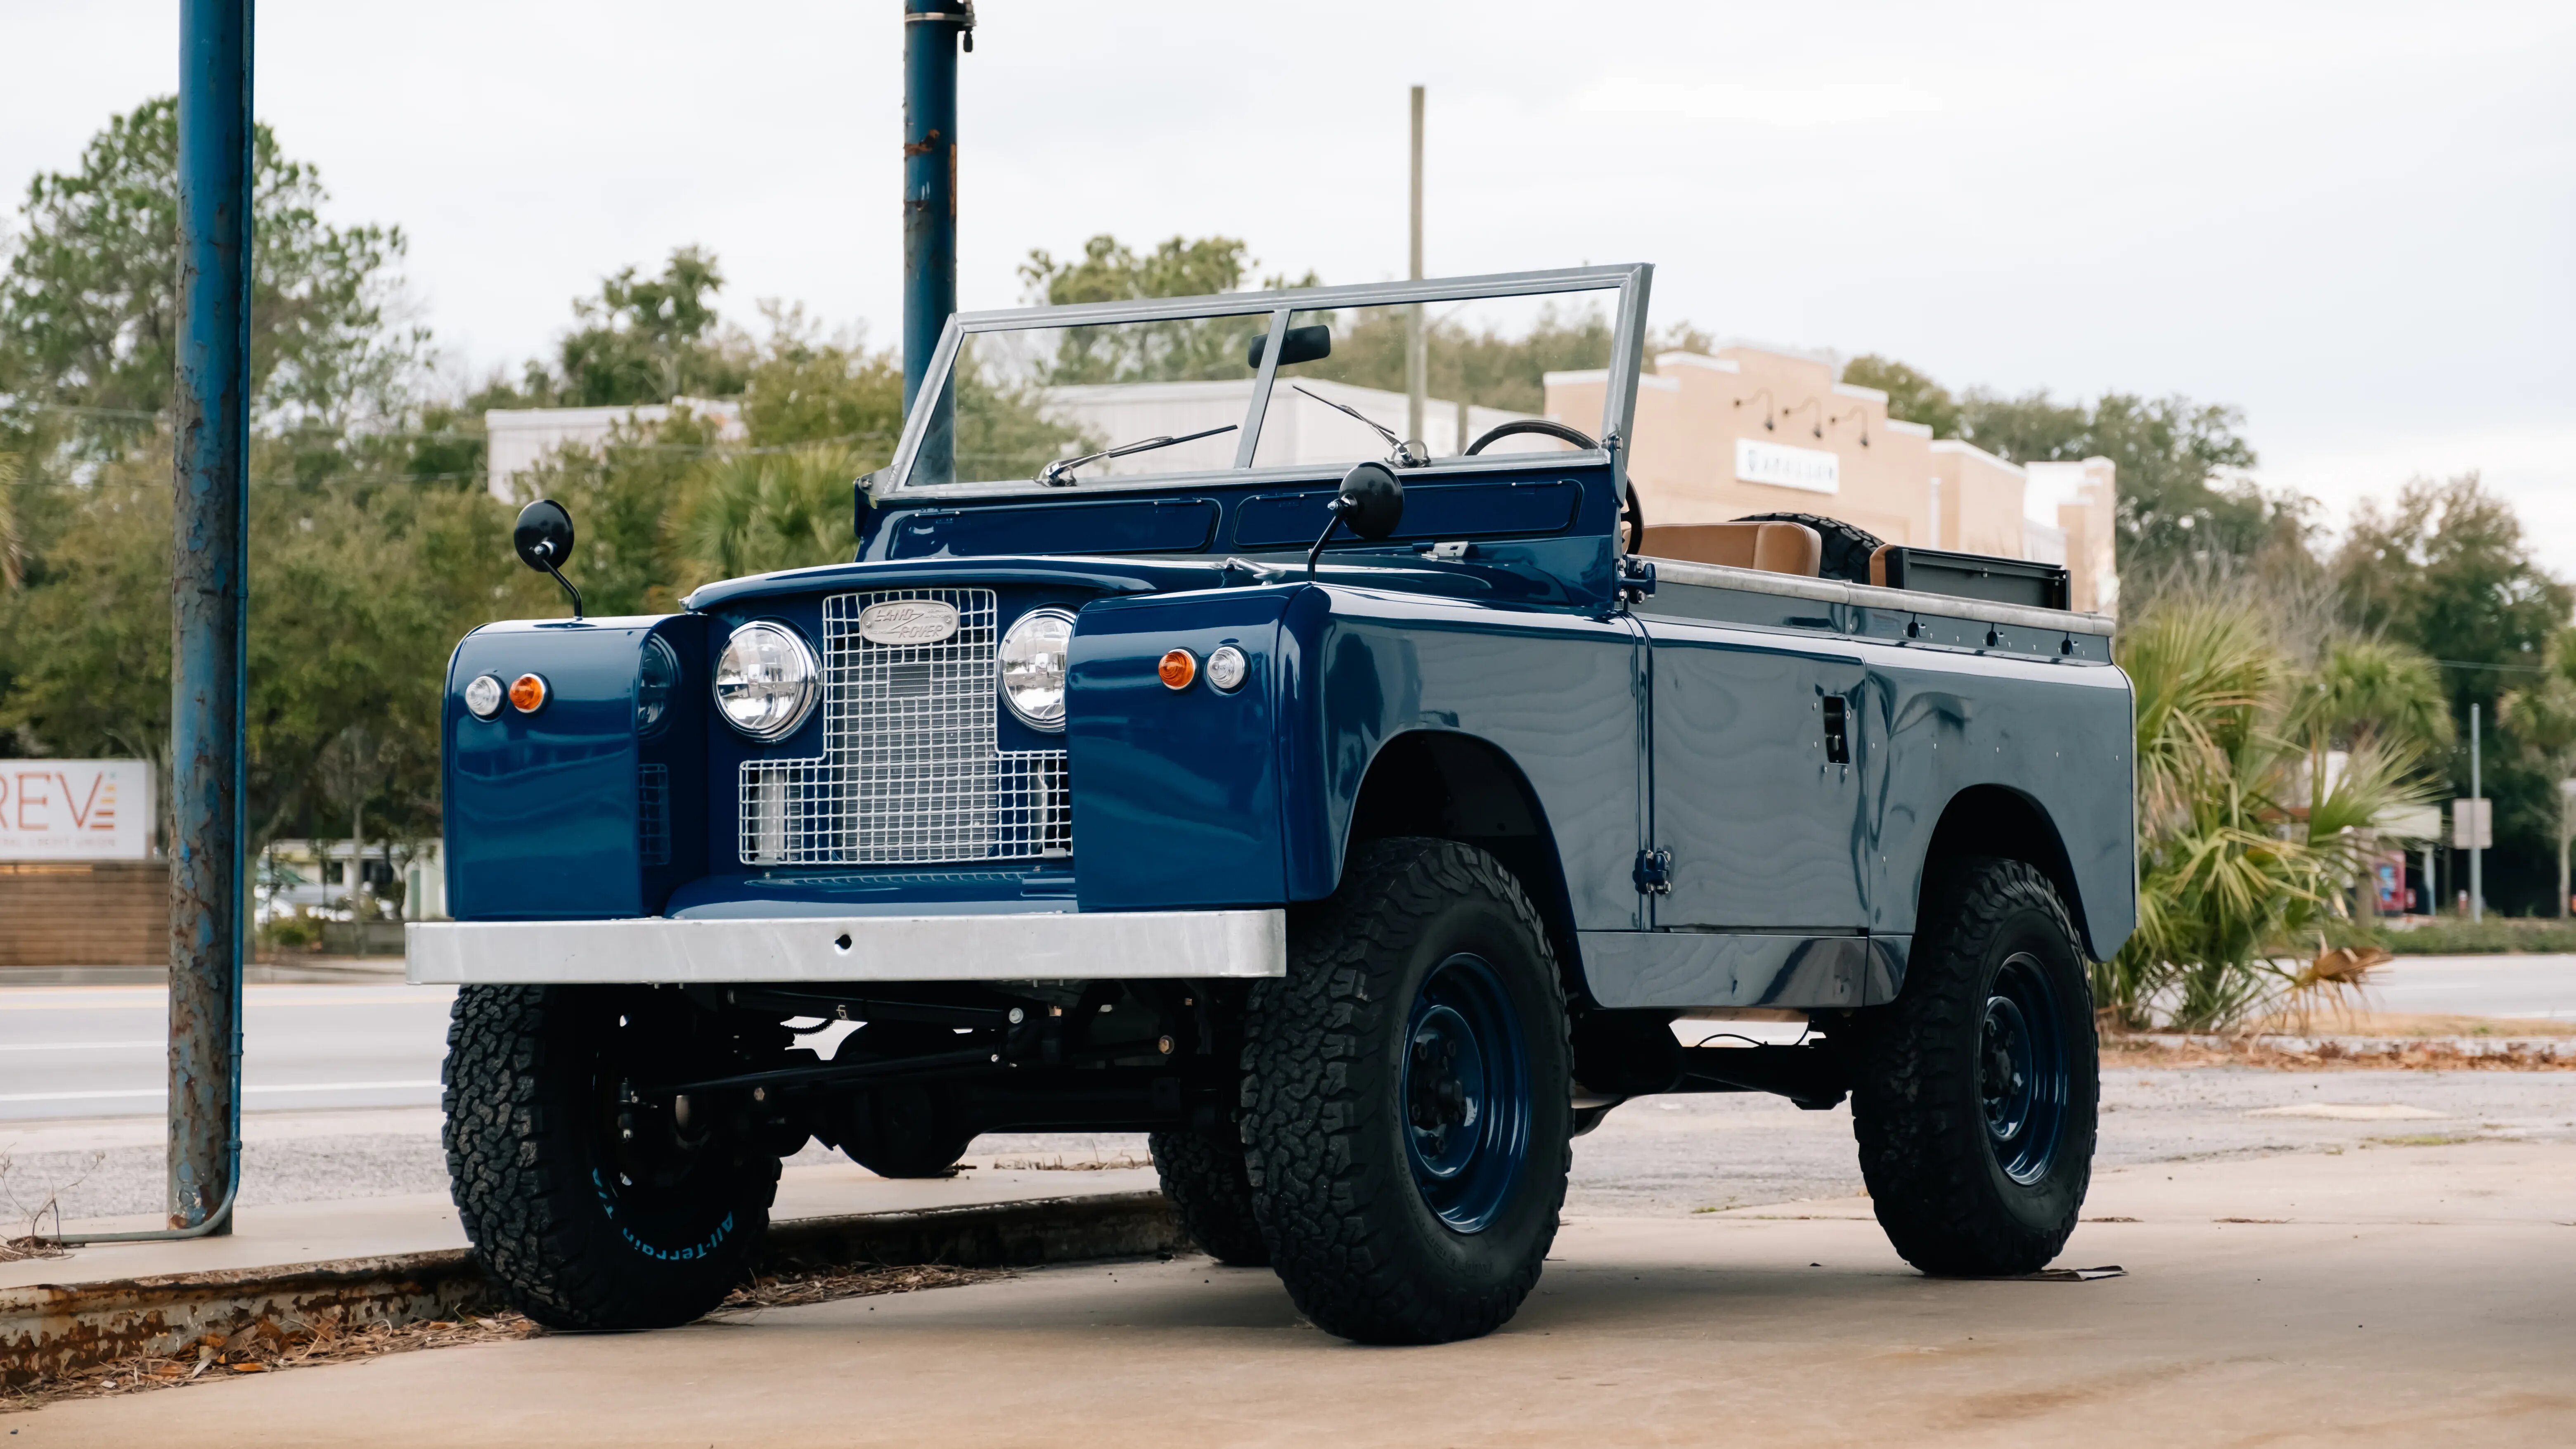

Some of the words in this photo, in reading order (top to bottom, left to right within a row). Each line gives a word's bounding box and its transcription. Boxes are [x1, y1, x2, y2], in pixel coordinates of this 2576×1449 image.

[874, 608, 914, 622] LAND
[898, 624, 944, 638] ROVER
[0, 772, 103, 831] EV
[623, 1211, 733, 1260] All-Terrain
